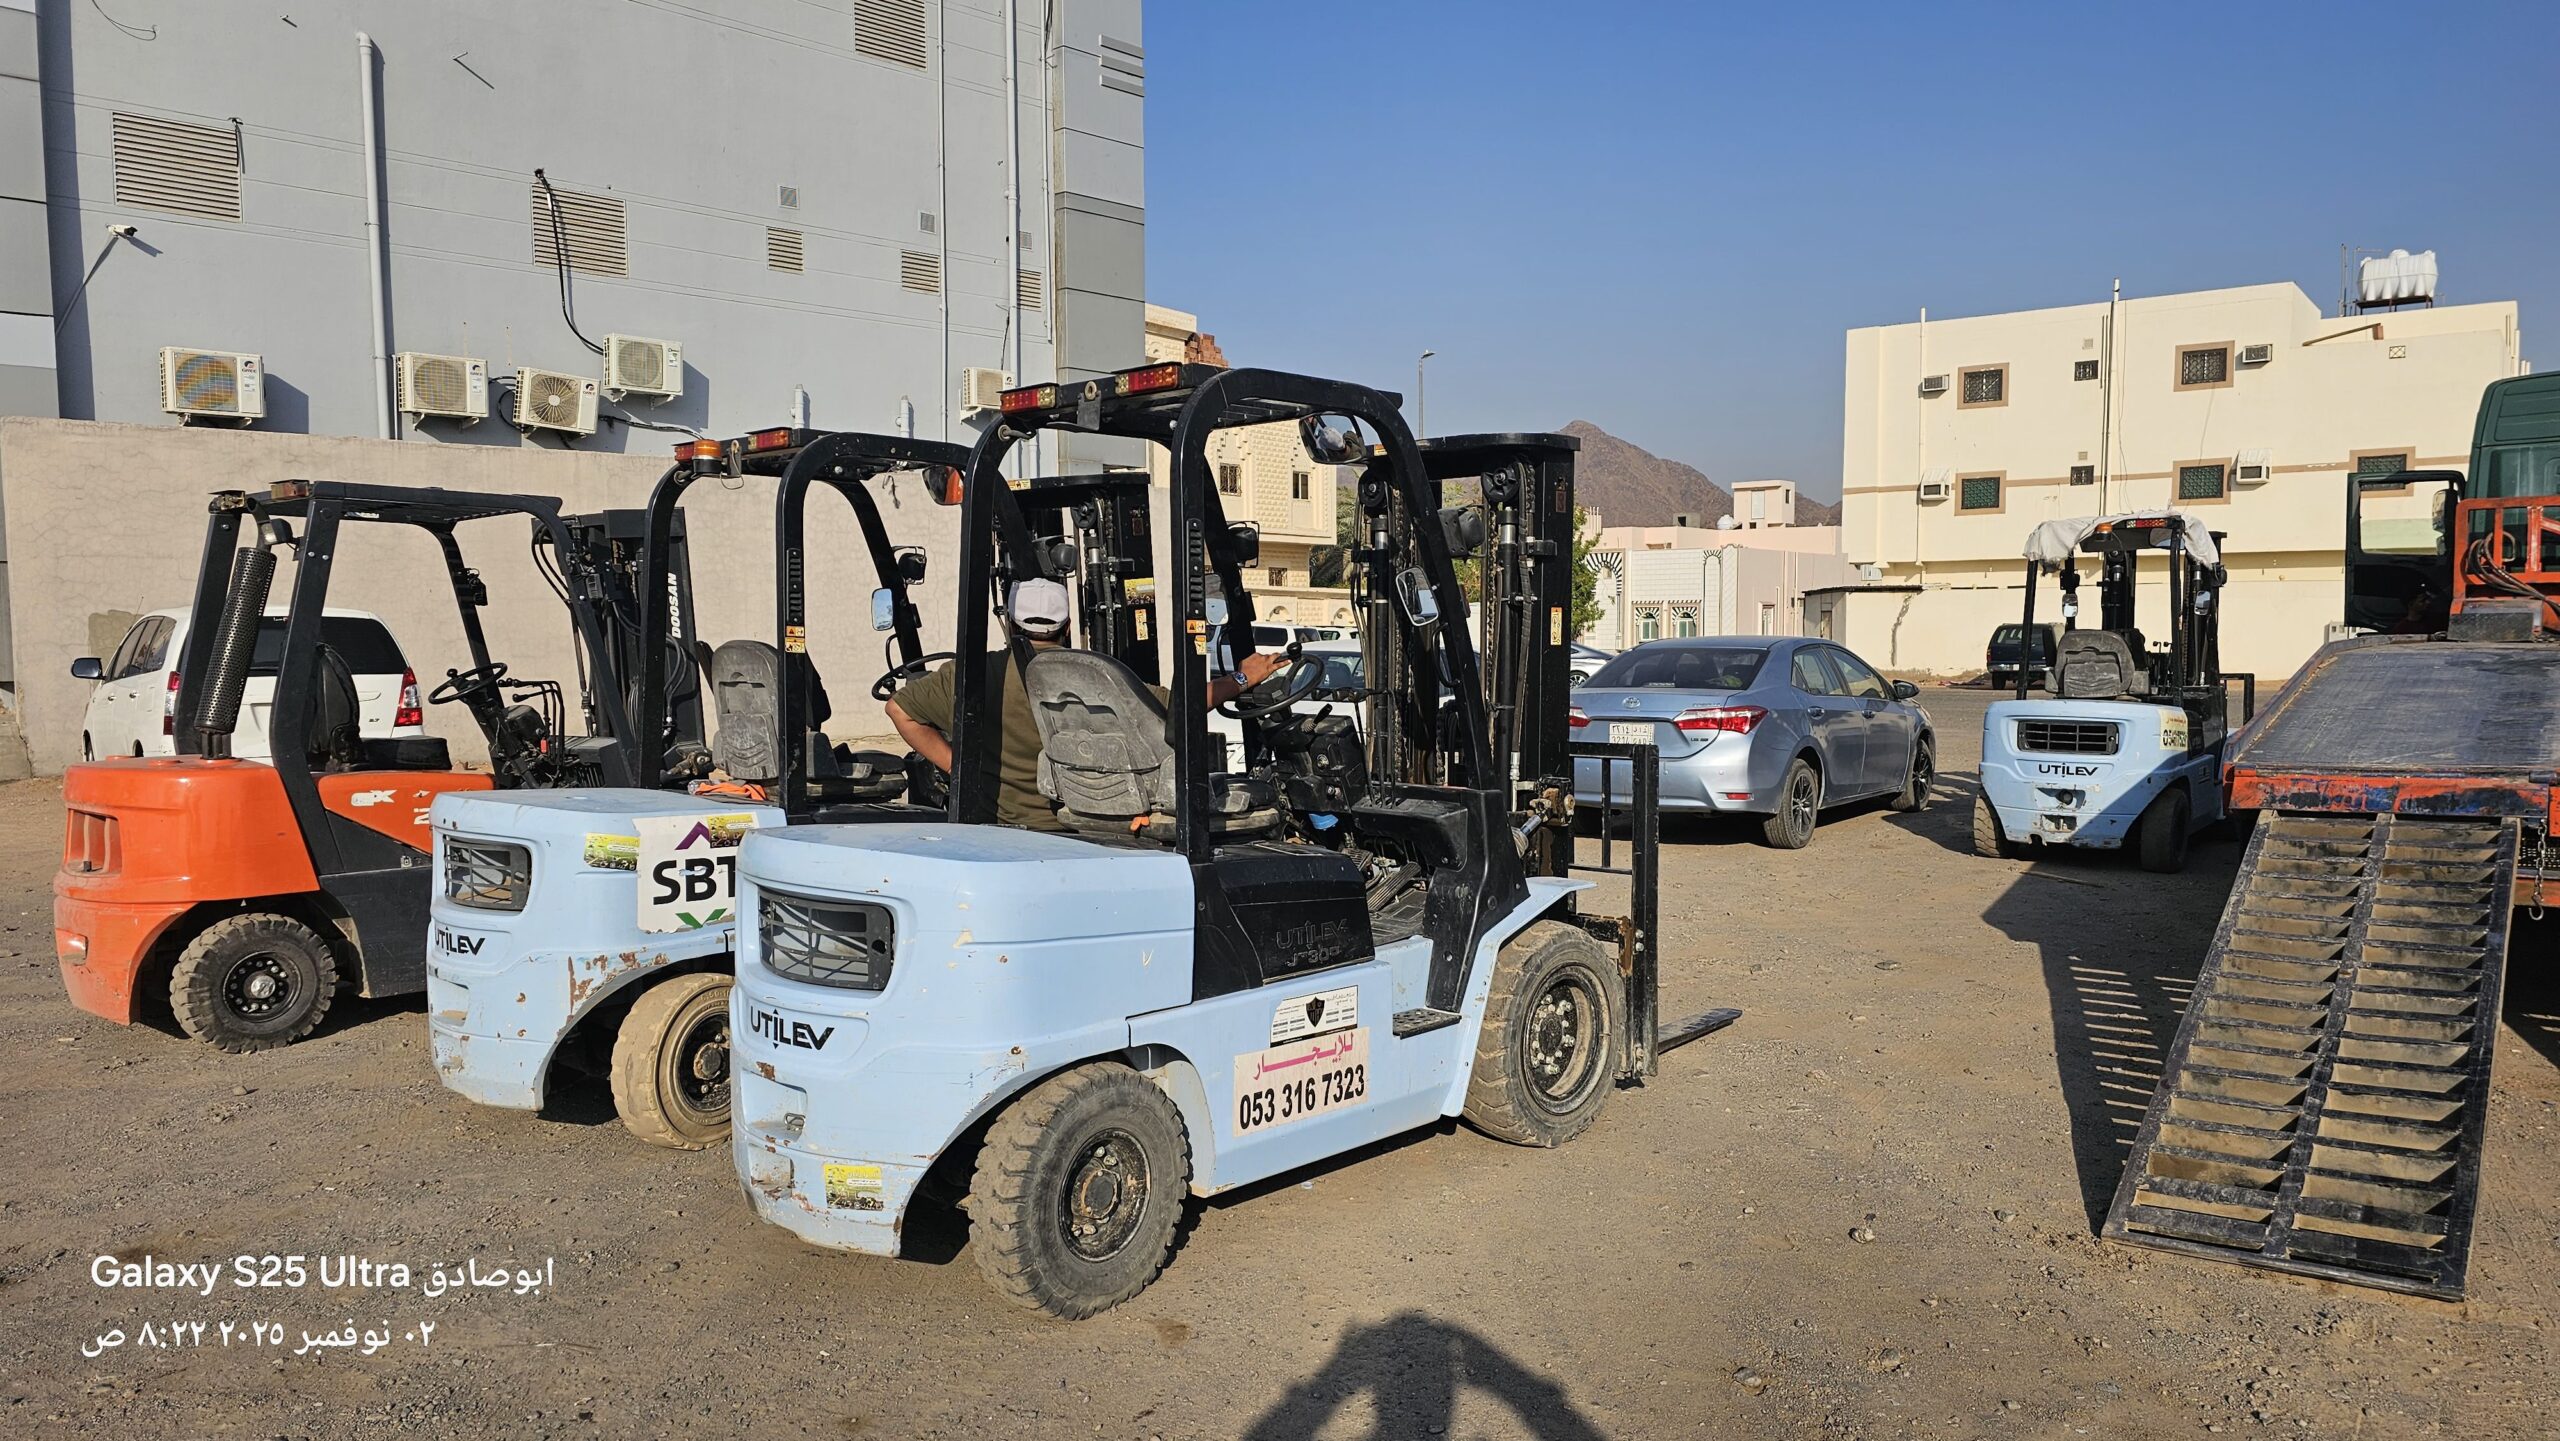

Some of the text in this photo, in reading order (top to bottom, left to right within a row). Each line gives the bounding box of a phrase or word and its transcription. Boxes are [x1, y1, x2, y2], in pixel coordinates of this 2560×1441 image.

[667, 572, 682, 639] DOOSAN
[2038, 762, 2099, 778] UTILEV
[652, 855, 736, 906] SBT
[434, 926, 486, 957] UTILEV
[1276, 918, 1348, 950] UTILEV
[750, 1005, 836, 1051] UTILEV
[1239, 1064, 1365, 1130] 053 316 7323
